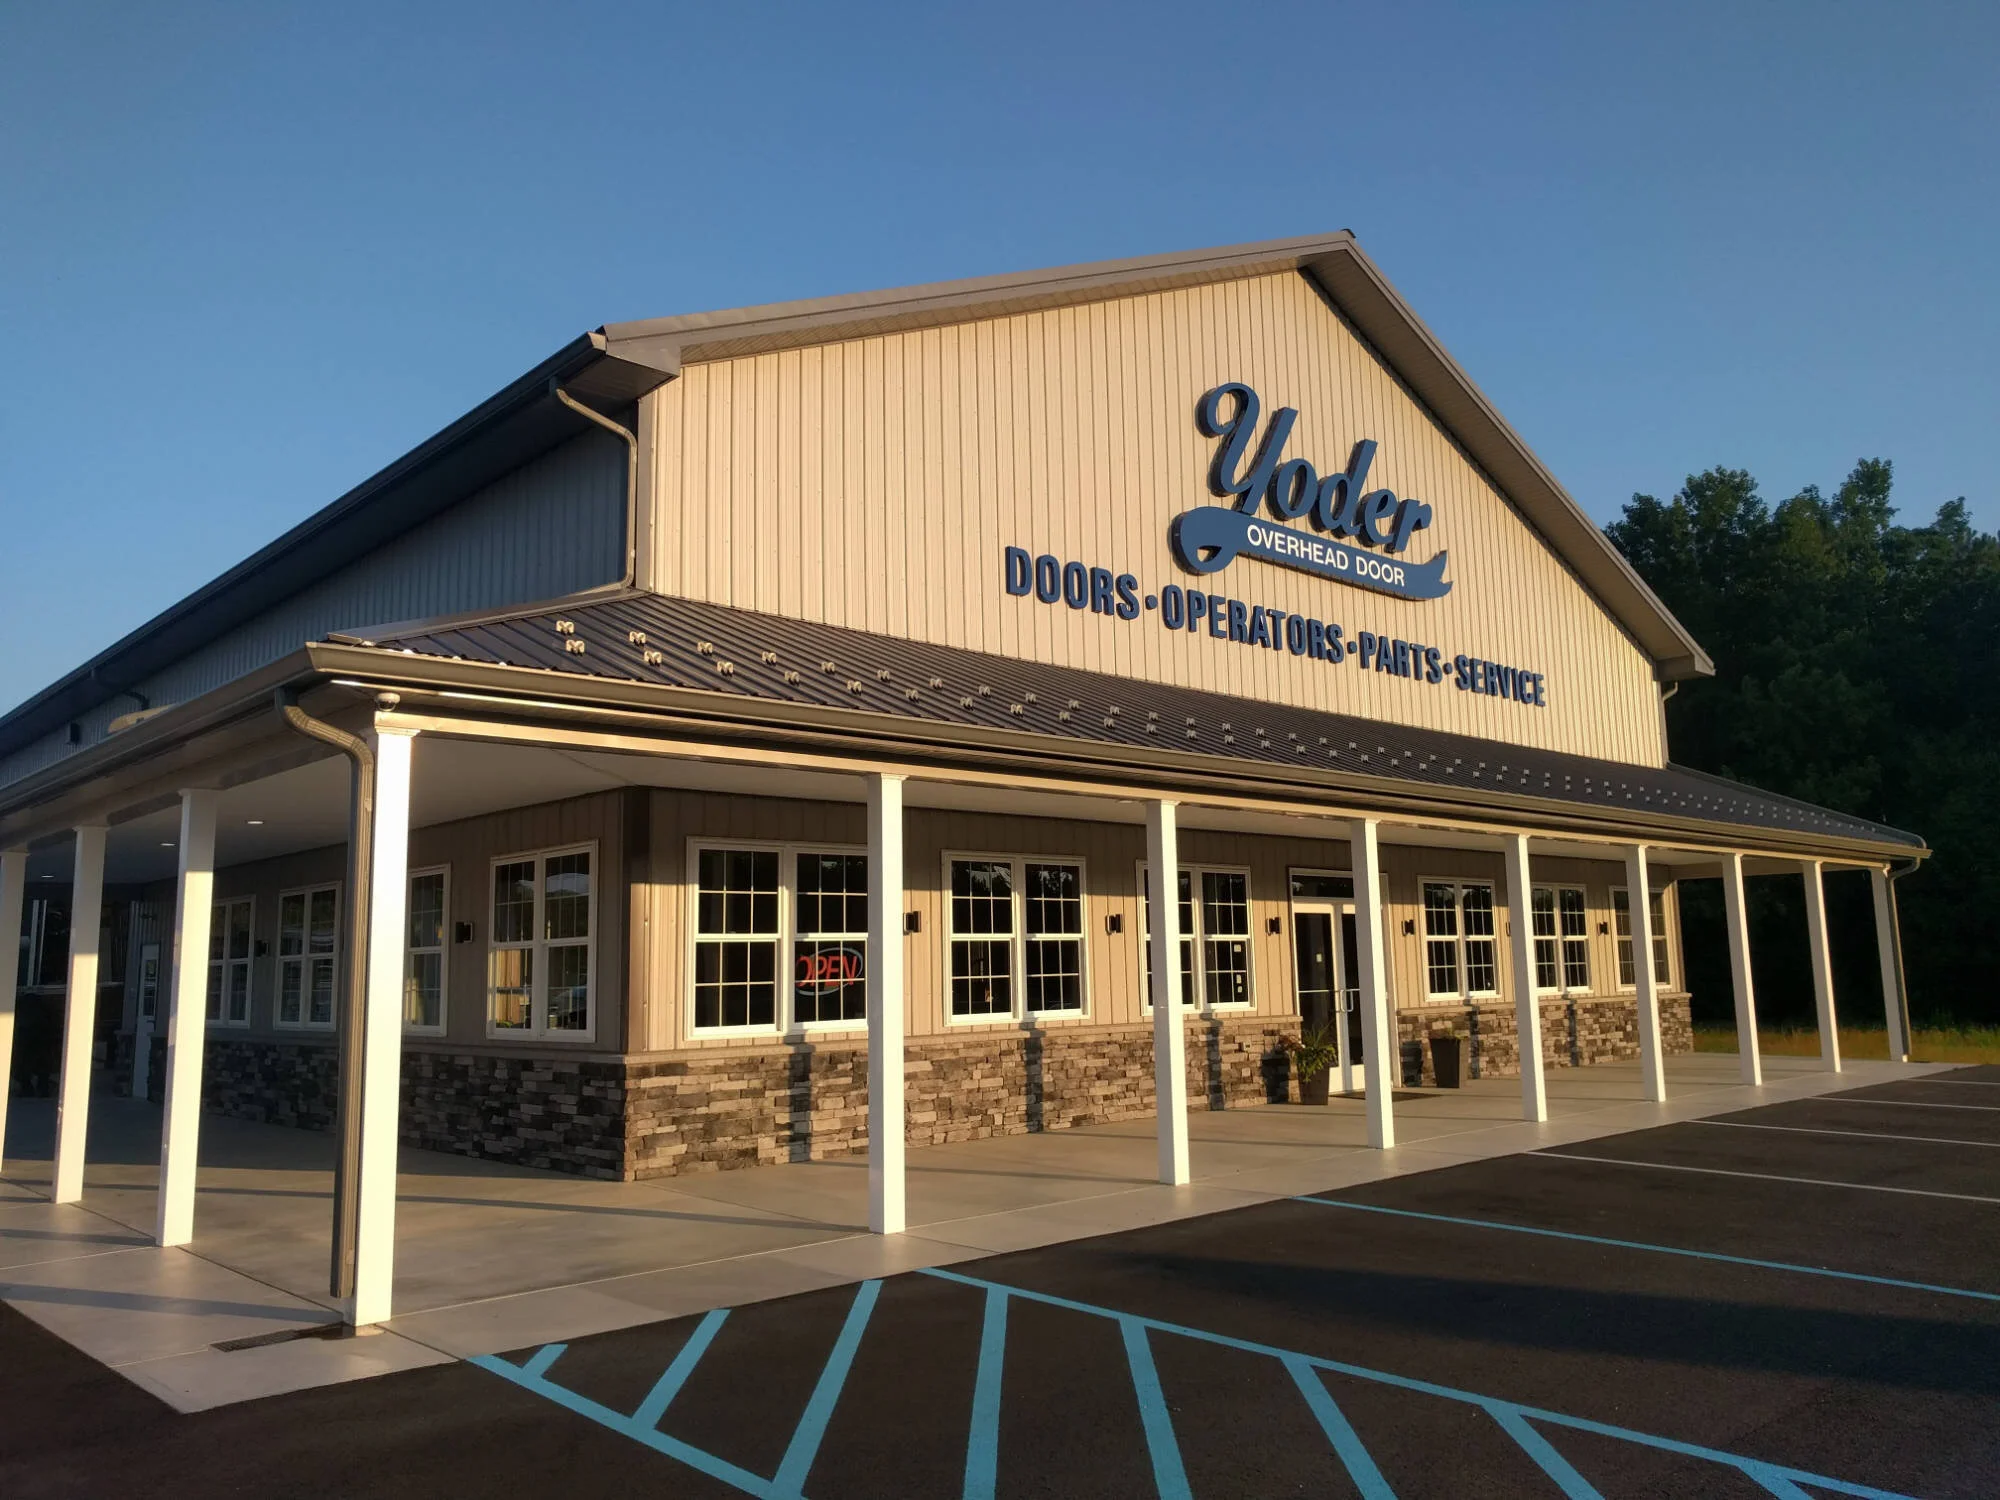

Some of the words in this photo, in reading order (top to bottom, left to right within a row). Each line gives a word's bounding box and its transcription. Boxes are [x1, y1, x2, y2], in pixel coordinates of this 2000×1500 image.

[1198, 382, 1432, 552] Yoder
[1247, 525, 1349, 571] OVERHEAD
[1356, 556, 1405, 587] DOOR
[1005, 546, 1140, 620] DOORS
[1162, 584, 1344, 664] OPERATORS
[1359, 631, 1442, 684] PARTS
[1454, 655, 1546, 707] SERVICE
[795, 954, 858, 987] OPEN
